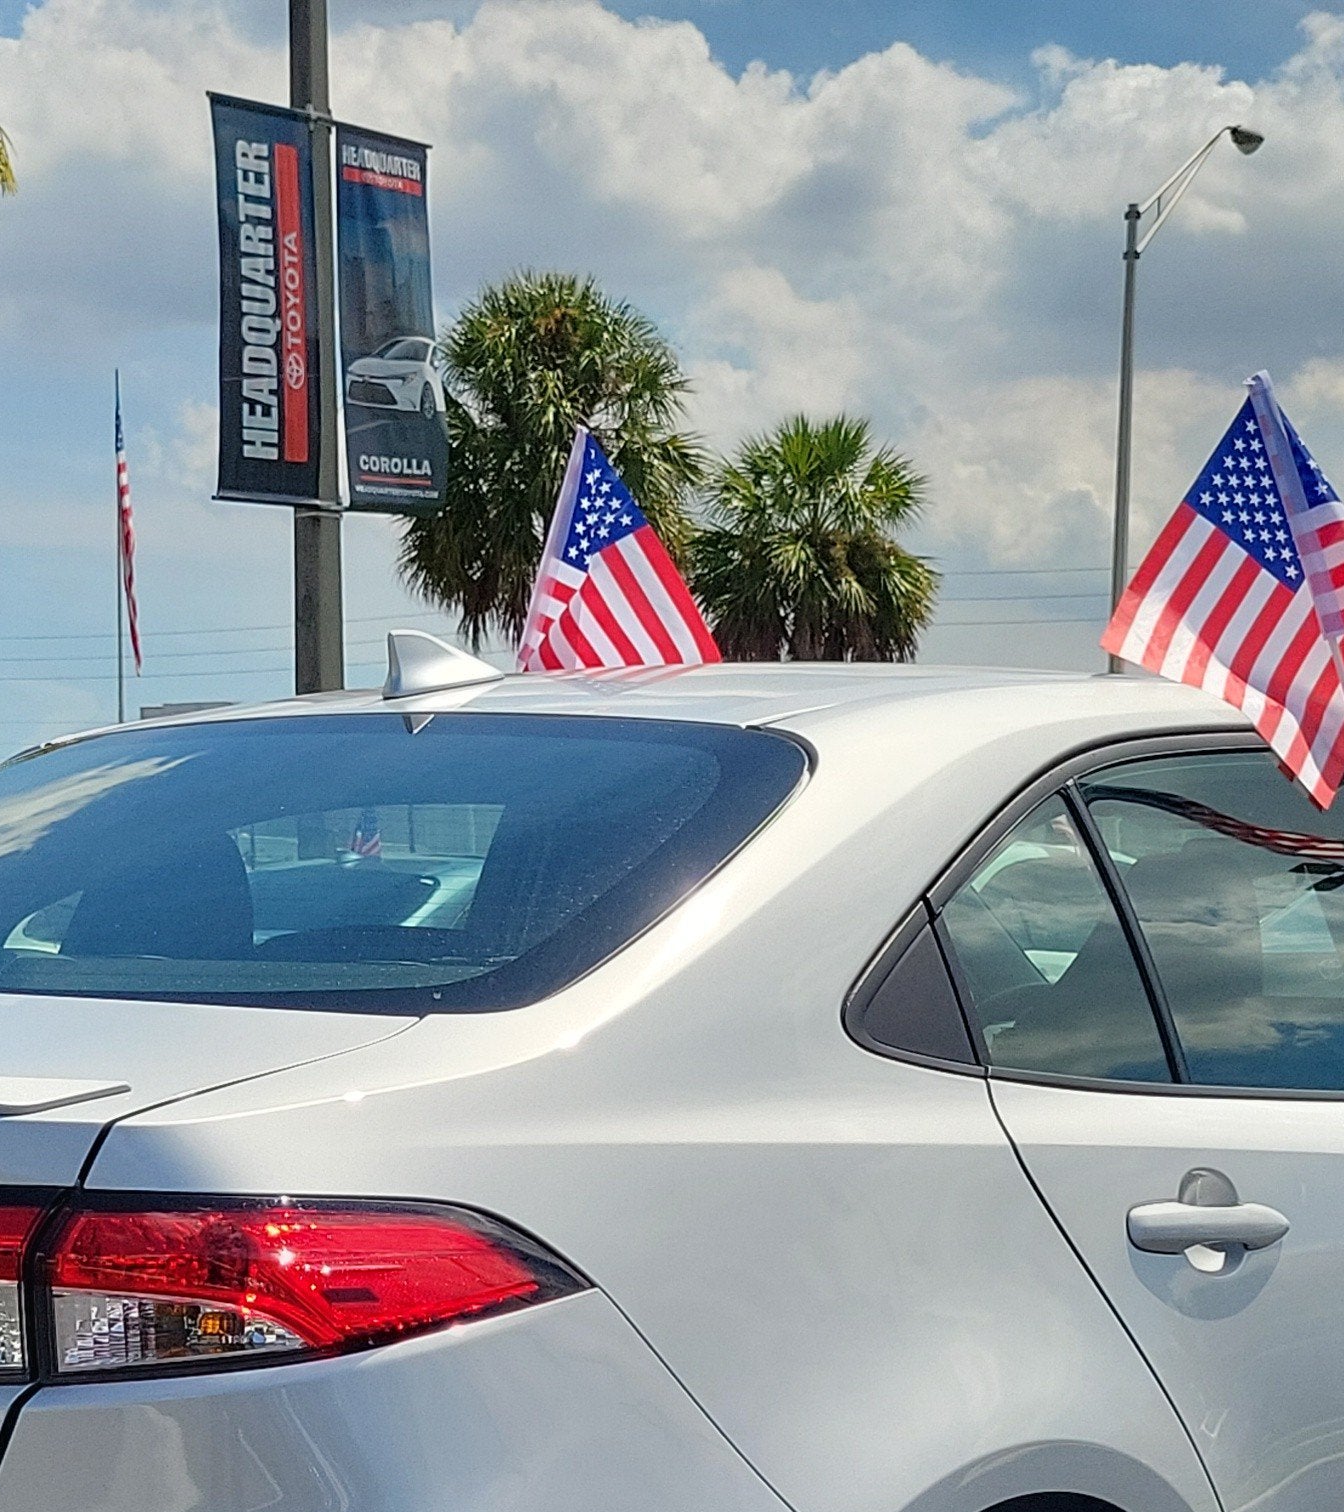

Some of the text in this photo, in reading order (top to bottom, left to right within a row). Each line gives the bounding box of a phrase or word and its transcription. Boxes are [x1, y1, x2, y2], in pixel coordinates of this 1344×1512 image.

[341, 144, 421, 182] HEADQUARTER
[235, 138, 280, 461] HEADQUARTER
[284, 231, 302, 350] TOYOTA
[359, 454, 433, 476] COROLLA
